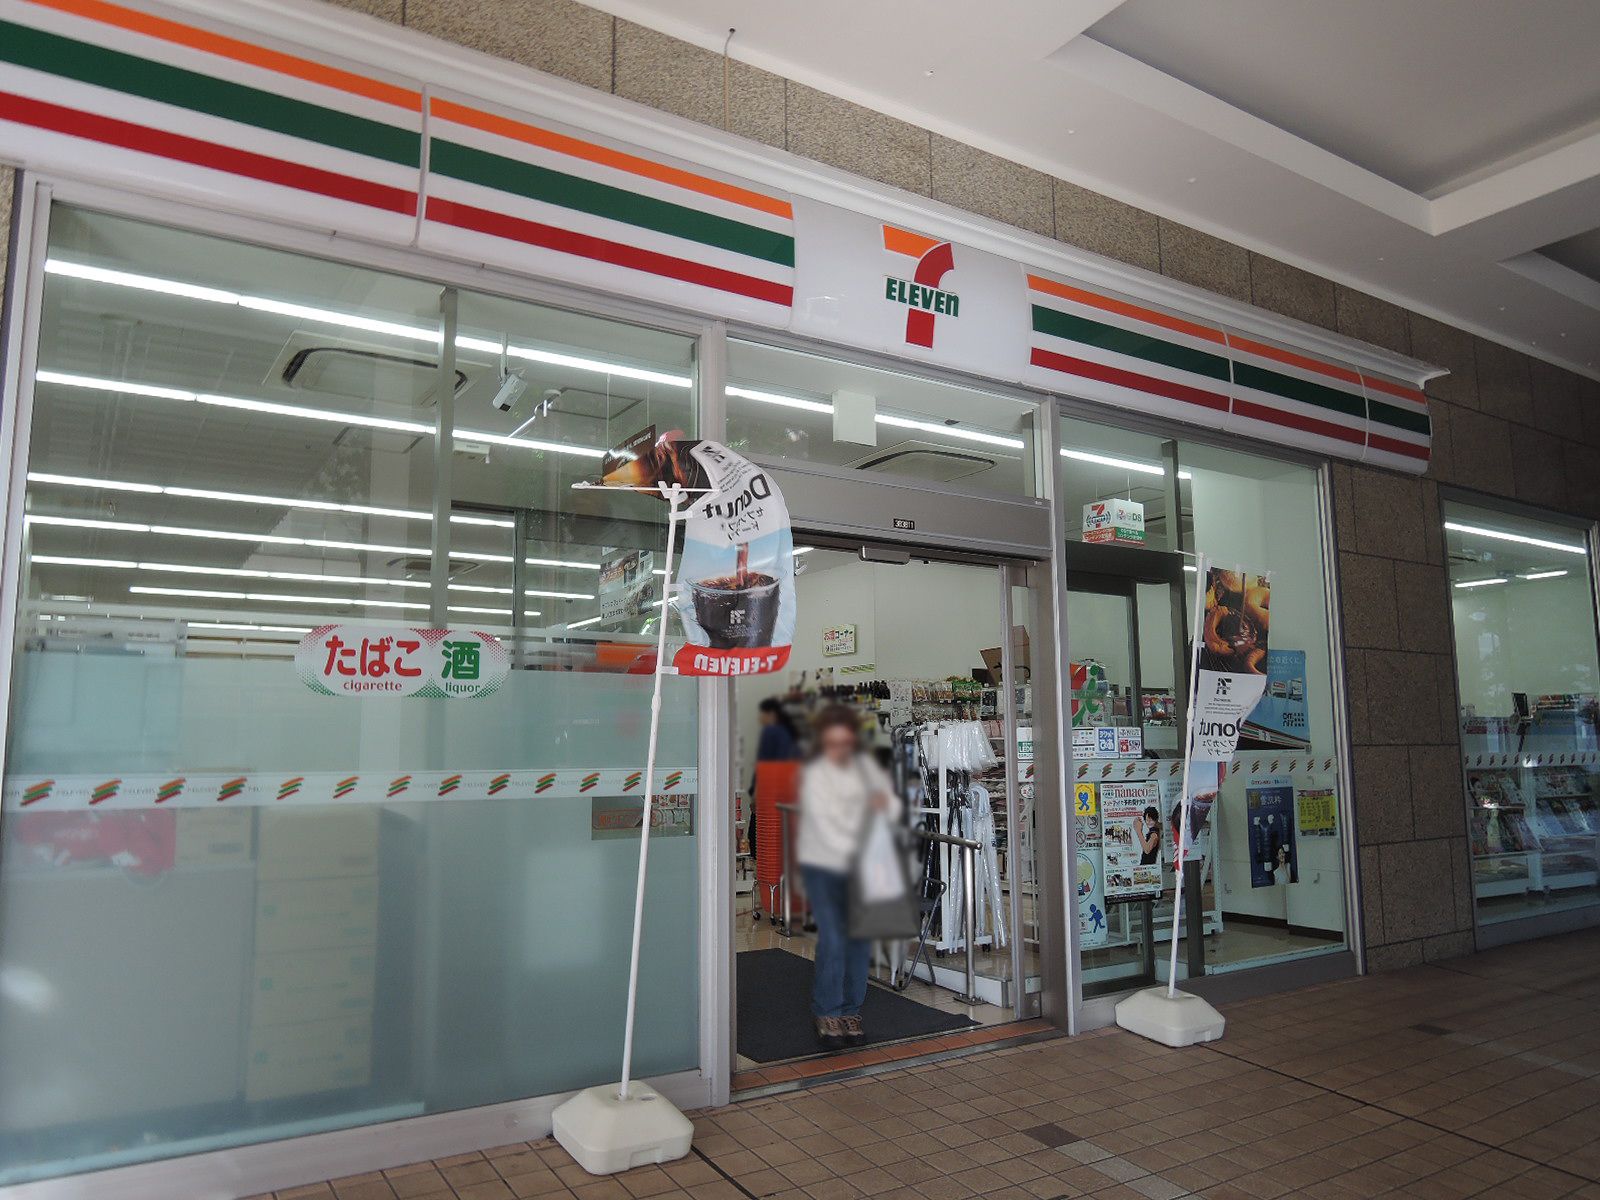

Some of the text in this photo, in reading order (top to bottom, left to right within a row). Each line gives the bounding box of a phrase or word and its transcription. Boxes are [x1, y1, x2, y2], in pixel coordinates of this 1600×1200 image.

[324, 635, 481, 680] たばこ 酒
[343, 679, 403, 692] cigarette
[445, 682, 481, 694] liquor
[1114, 788, 1148, 799] nanaco
